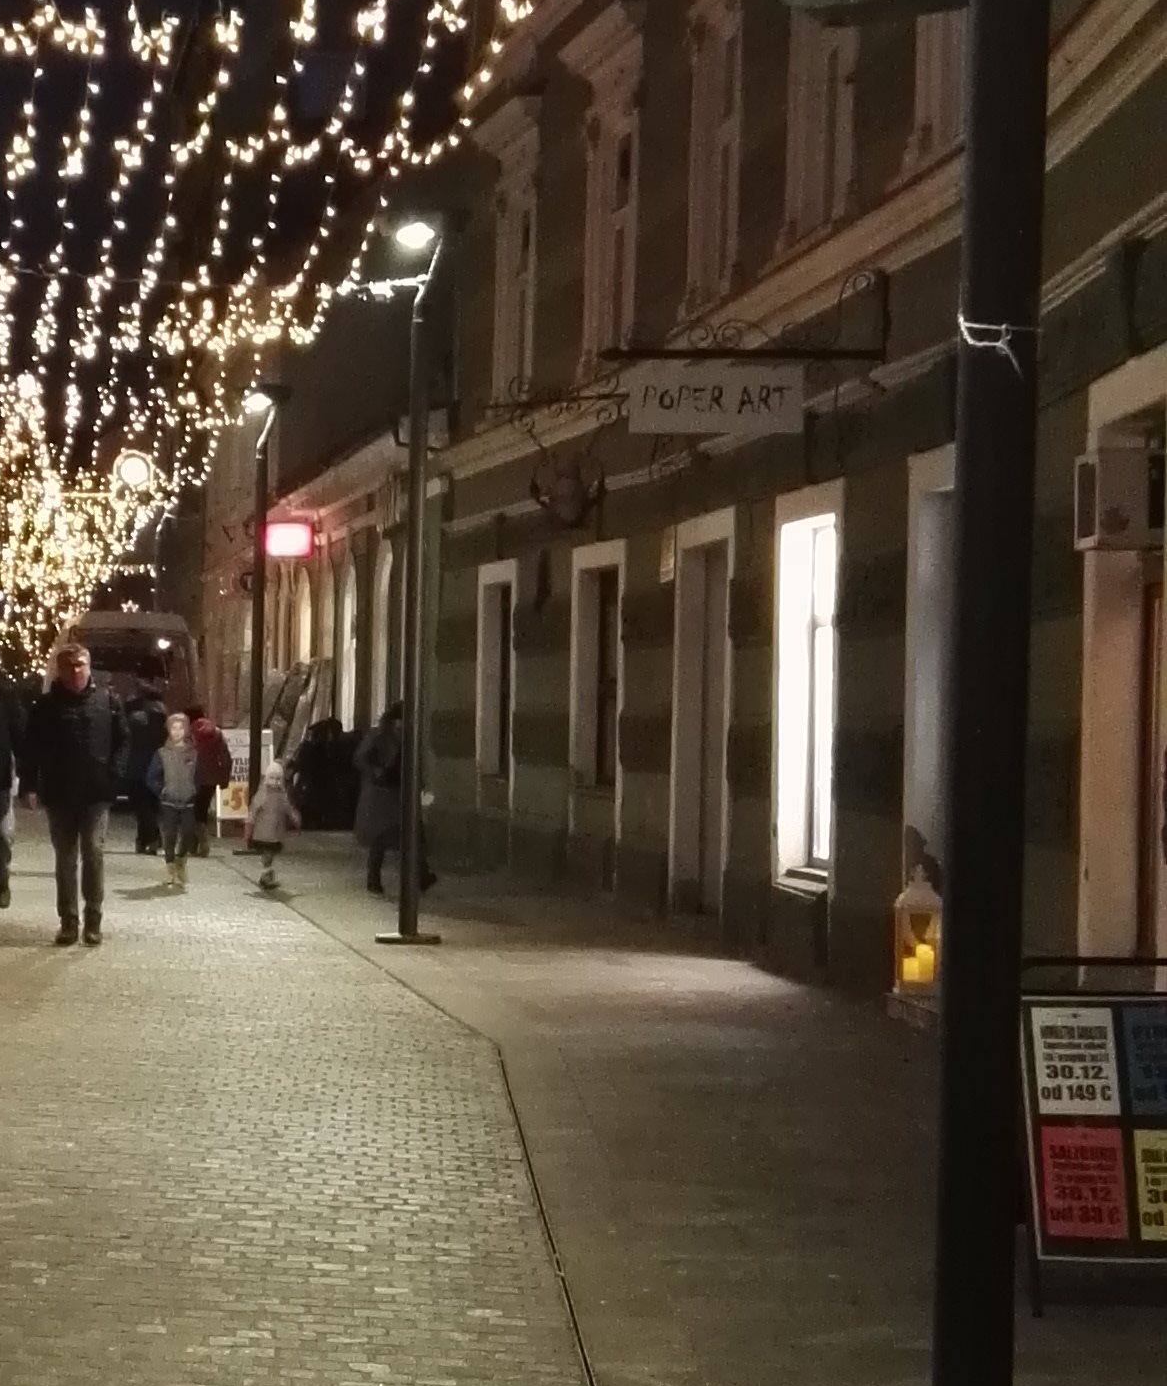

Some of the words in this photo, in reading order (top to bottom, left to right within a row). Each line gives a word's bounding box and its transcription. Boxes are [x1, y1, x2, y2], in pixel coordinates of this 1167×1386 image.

[641, 384, 726, 414] POPER
[737, 384, 792, 414] ART
[1045, 1063, 1109, 1080] 30.12.
[1040, 1084, 1063, 1101] od
[1066, 1083, 1097, 1102] 149
